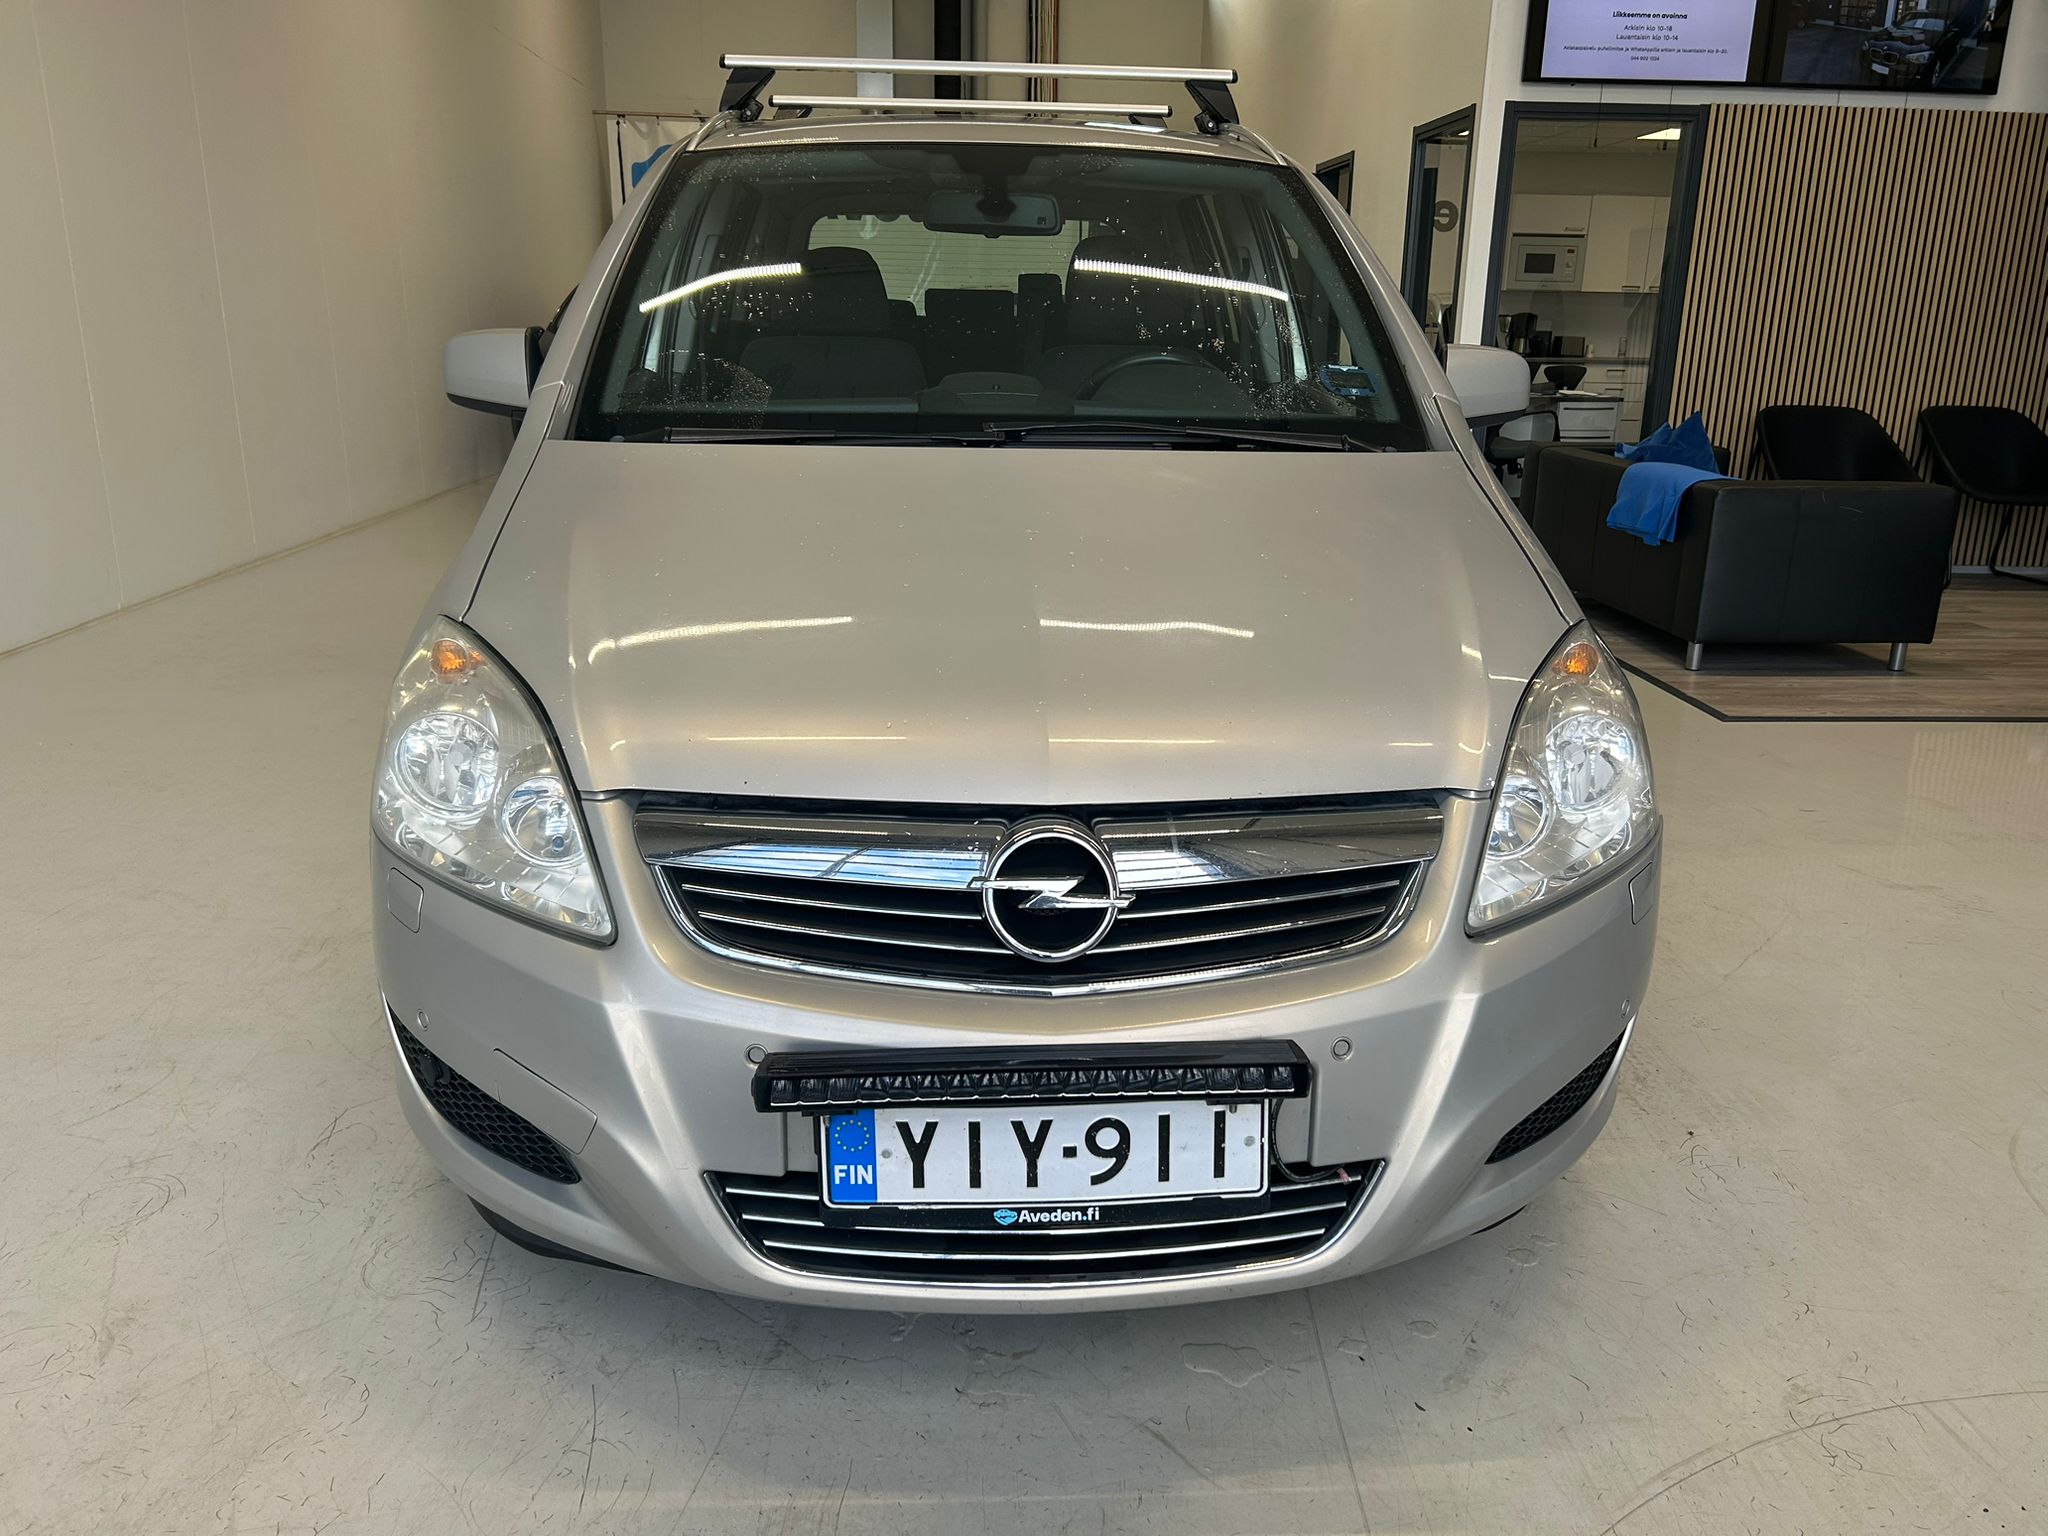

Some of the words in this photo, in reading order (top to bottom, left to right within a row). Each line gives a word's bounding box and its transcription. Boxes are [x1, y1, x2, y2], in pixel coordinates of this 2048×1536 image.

[896, 1109, 1226, 1189] YIY-911
[834, 1164, 874, 1185] FIN
[1018, 1207, 1100, 1223] Aveden.fi
